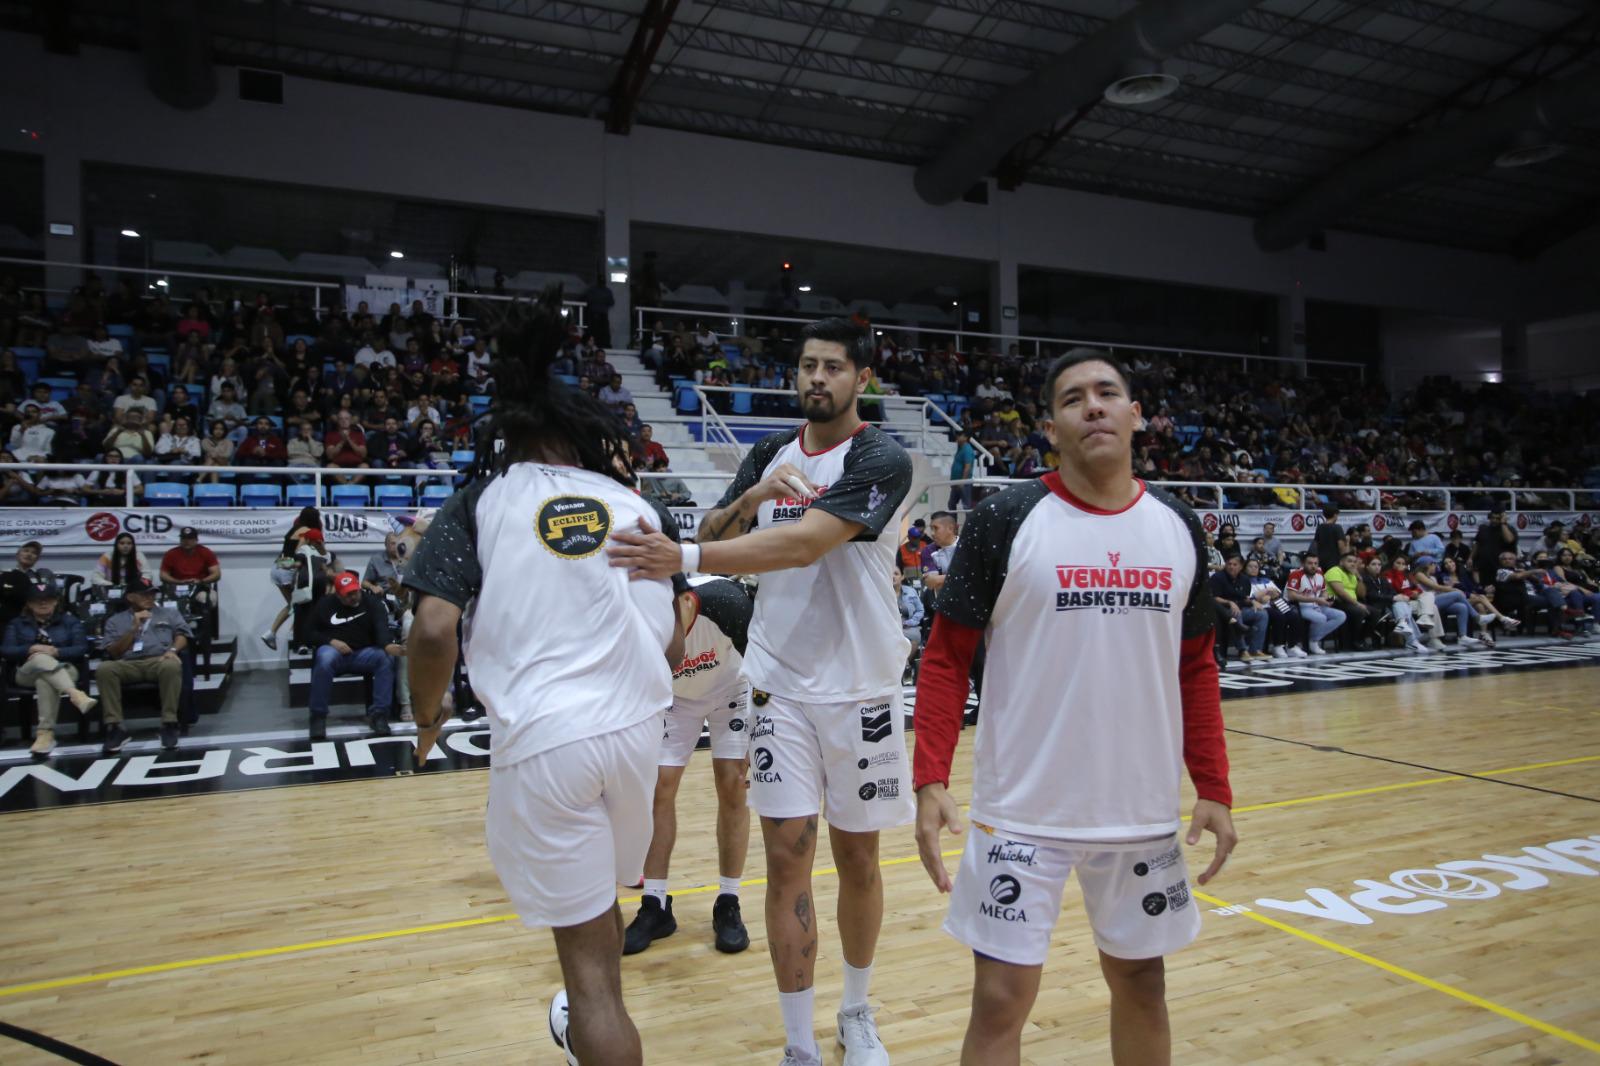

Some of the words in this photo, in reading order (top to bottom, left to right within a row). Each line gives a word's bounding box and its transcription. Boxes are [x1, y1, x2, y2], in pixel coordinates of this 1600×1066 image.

[123, 514, 173, 533] CID
[325, 513, 368, 532] UAD
[552, 514, 596, 526] ECLIPSE
[672, 512, 695, 530] AD
[239, 527, 272, 535] LOBOS
[1056, 568, 1173, 591] VENADOS
[1056, 591, 1171, 609] BASKETBALL
[860, 703, 890, 715] Chevron
[987, 844, 1036, 866] Huichol
[979, 901, 1027, 923] MEGA
